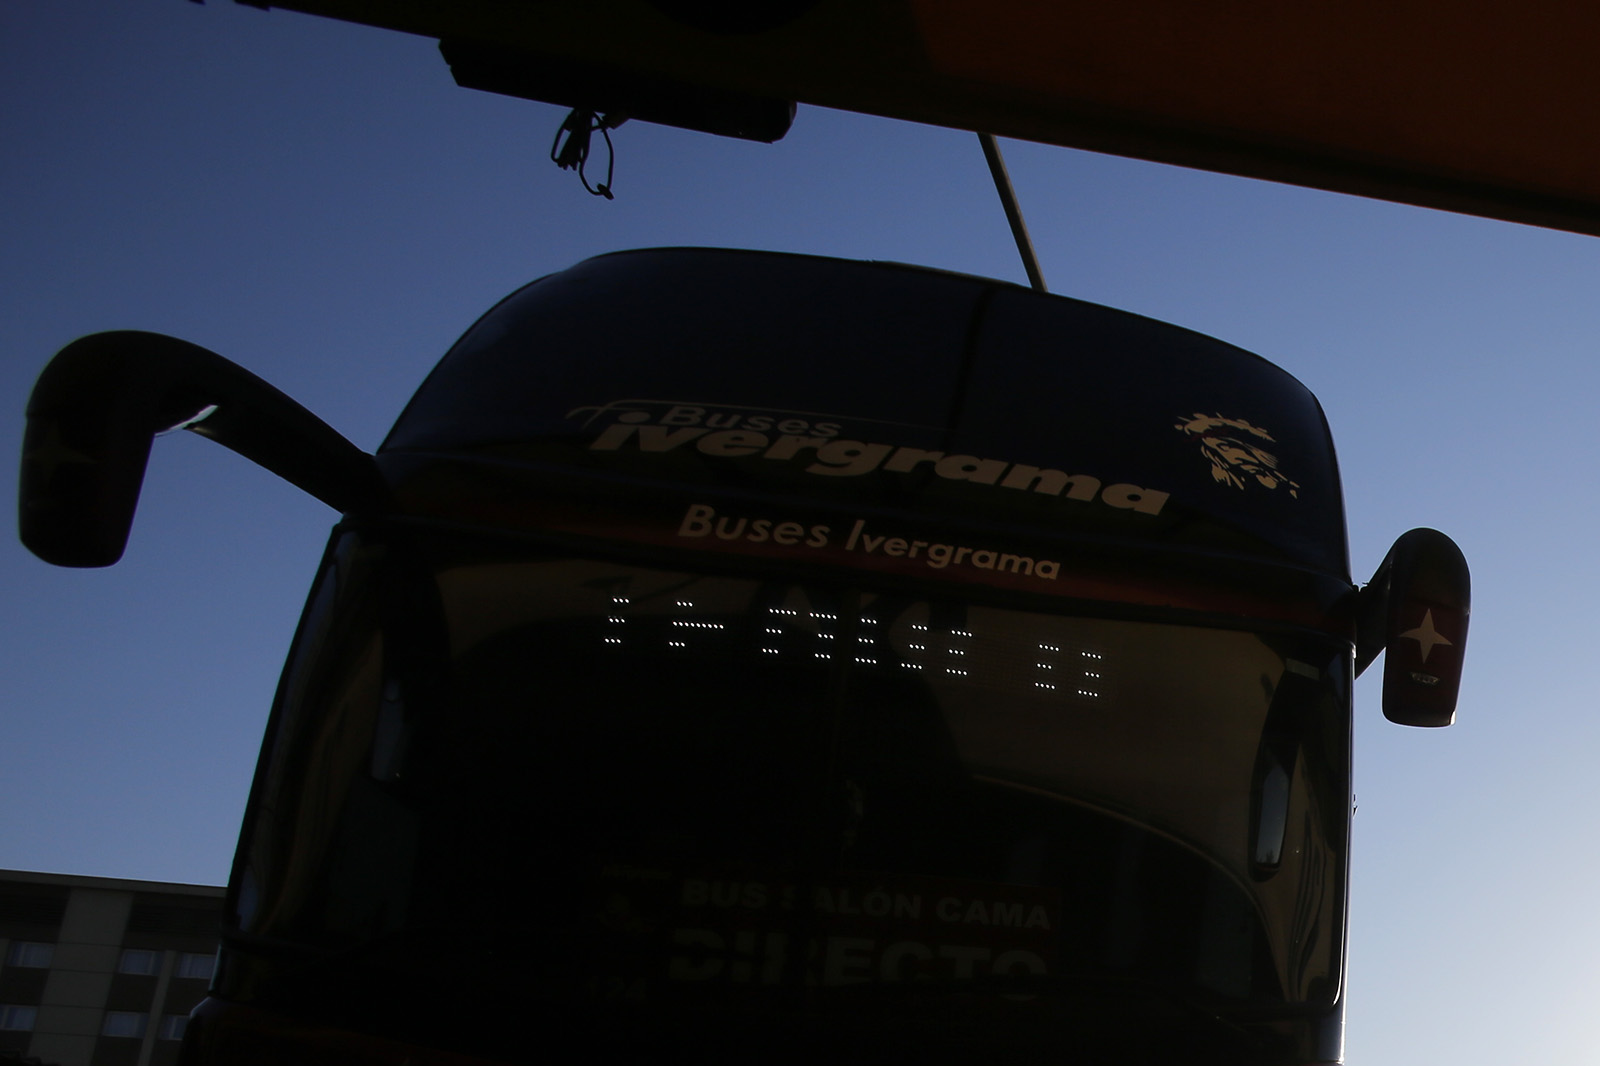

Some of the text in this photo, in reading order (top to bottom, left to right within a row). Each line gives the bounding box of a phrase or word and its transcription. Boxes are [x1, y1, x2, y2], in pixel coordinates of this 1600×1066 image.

[660, 404, 843, 437] Buses
[676, 504, 1063, 580] Buses Ivergrama
[681, 879, 768, 910] BUS
[934, 897, 1052, 930] CAMA
